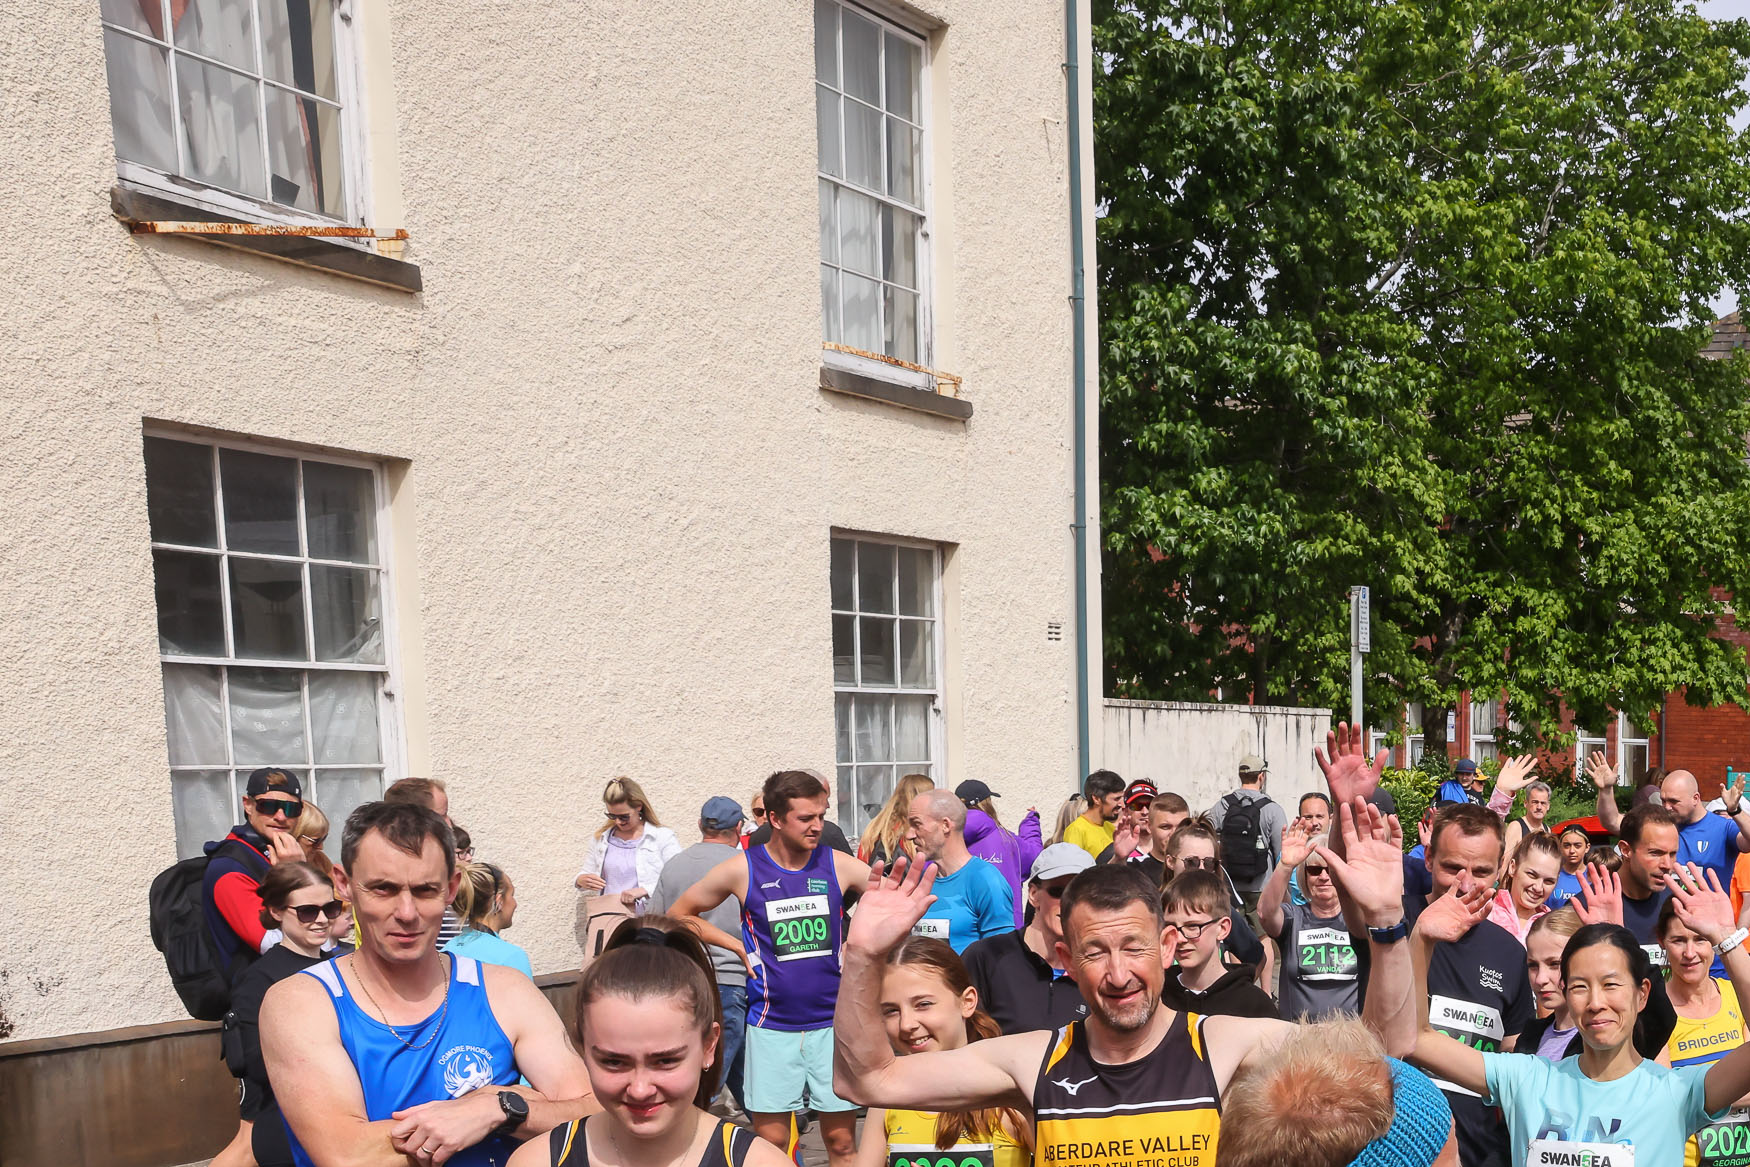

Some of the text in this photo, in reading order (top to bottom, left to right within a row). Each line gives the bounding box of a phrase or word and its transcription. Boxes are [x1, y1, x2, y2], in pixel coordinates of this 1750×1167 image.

[774, 918, 827, 946] 2009
[790, 943, 819, 953] GARETH
[1302, 946, 1356, 966] 2112
[1677, 1029, 1740, 1052] BRIDGEND
[438, 1045, 466, 1066] OGMORE
[1043, 1133, 1211, 1163] ABERDARE VALLEY
[1168, 1156, 1200, 1167] CLUB
